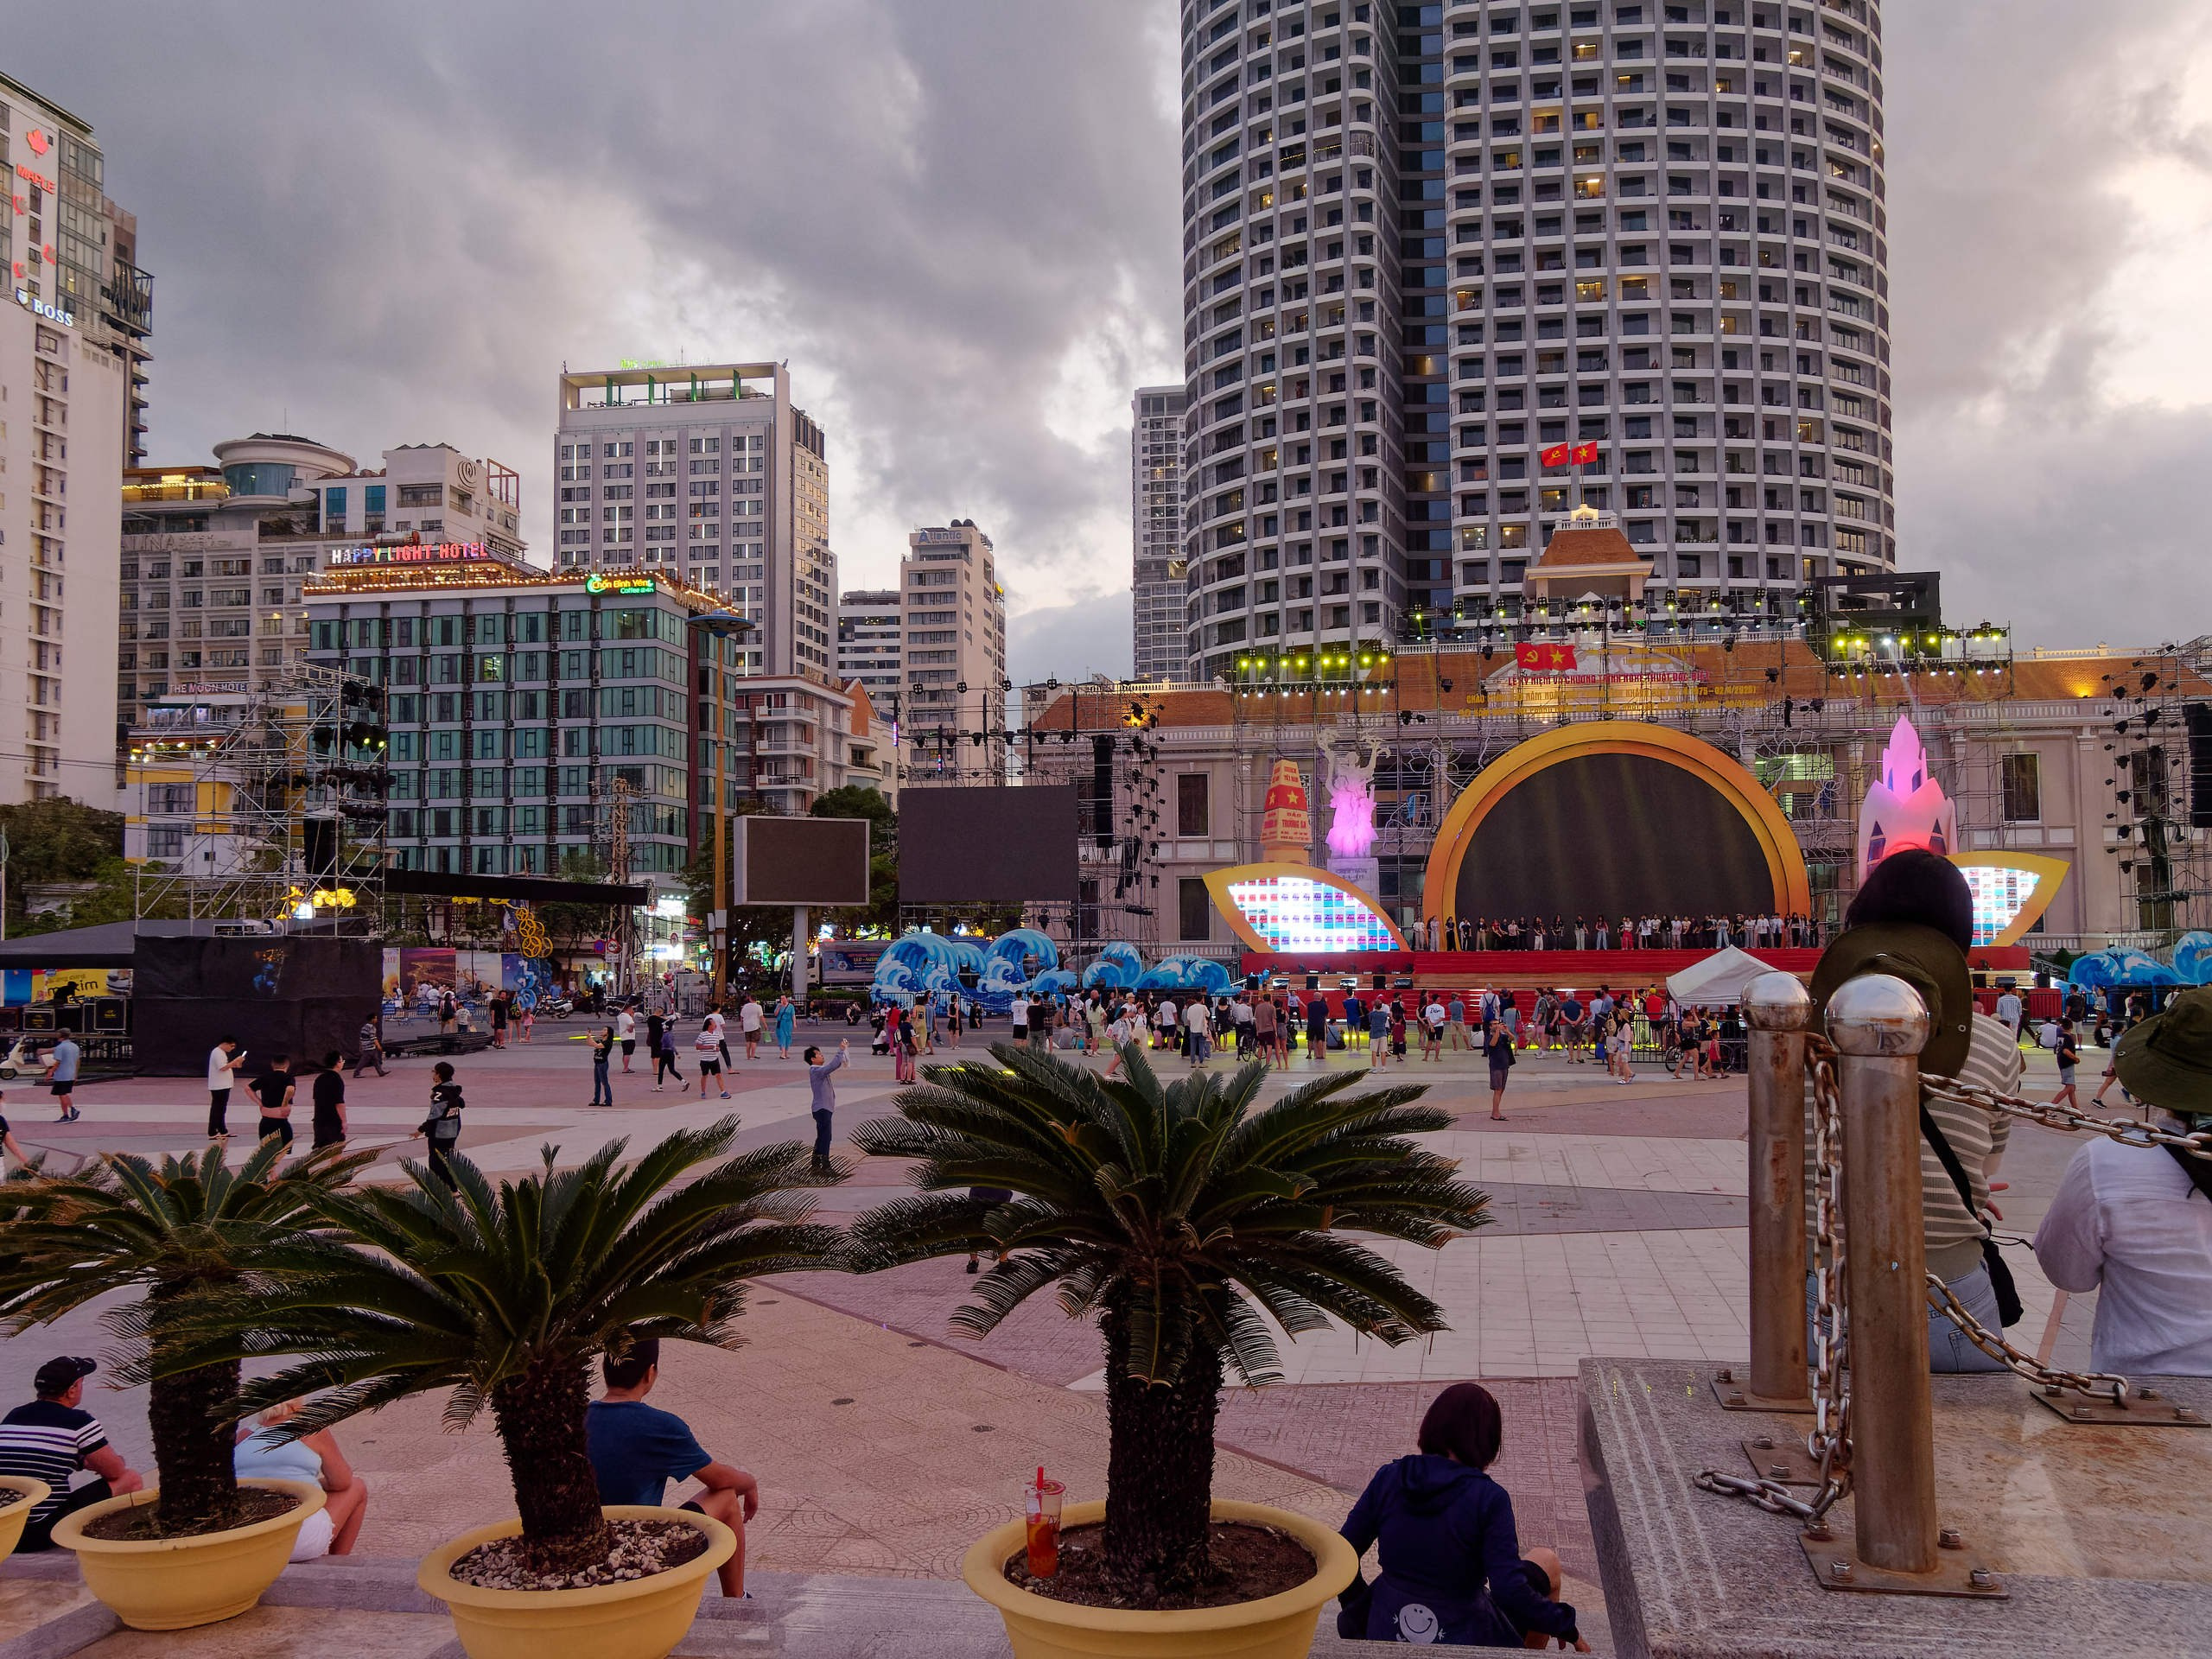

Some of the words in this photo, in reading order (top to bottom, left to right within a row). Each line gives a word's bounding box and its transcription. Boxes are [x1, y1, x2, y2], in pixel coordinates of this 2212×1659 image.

[16, 163, 55, 194] MAPLE
[32, 298, 73, 327] BOSS
[332, 548, 381, 563] HAPPY
[388, 544, 433, 562] LIGHT
[439, 542, 488, 560] HOTEL
[592, 579, 613, 588] Chốn
[169, 683, 188, 693] THE
[188, 683, 219, 693] MOON
[221, 682, 248, 692] HOTE
[48, 980, 99, 996] mim
